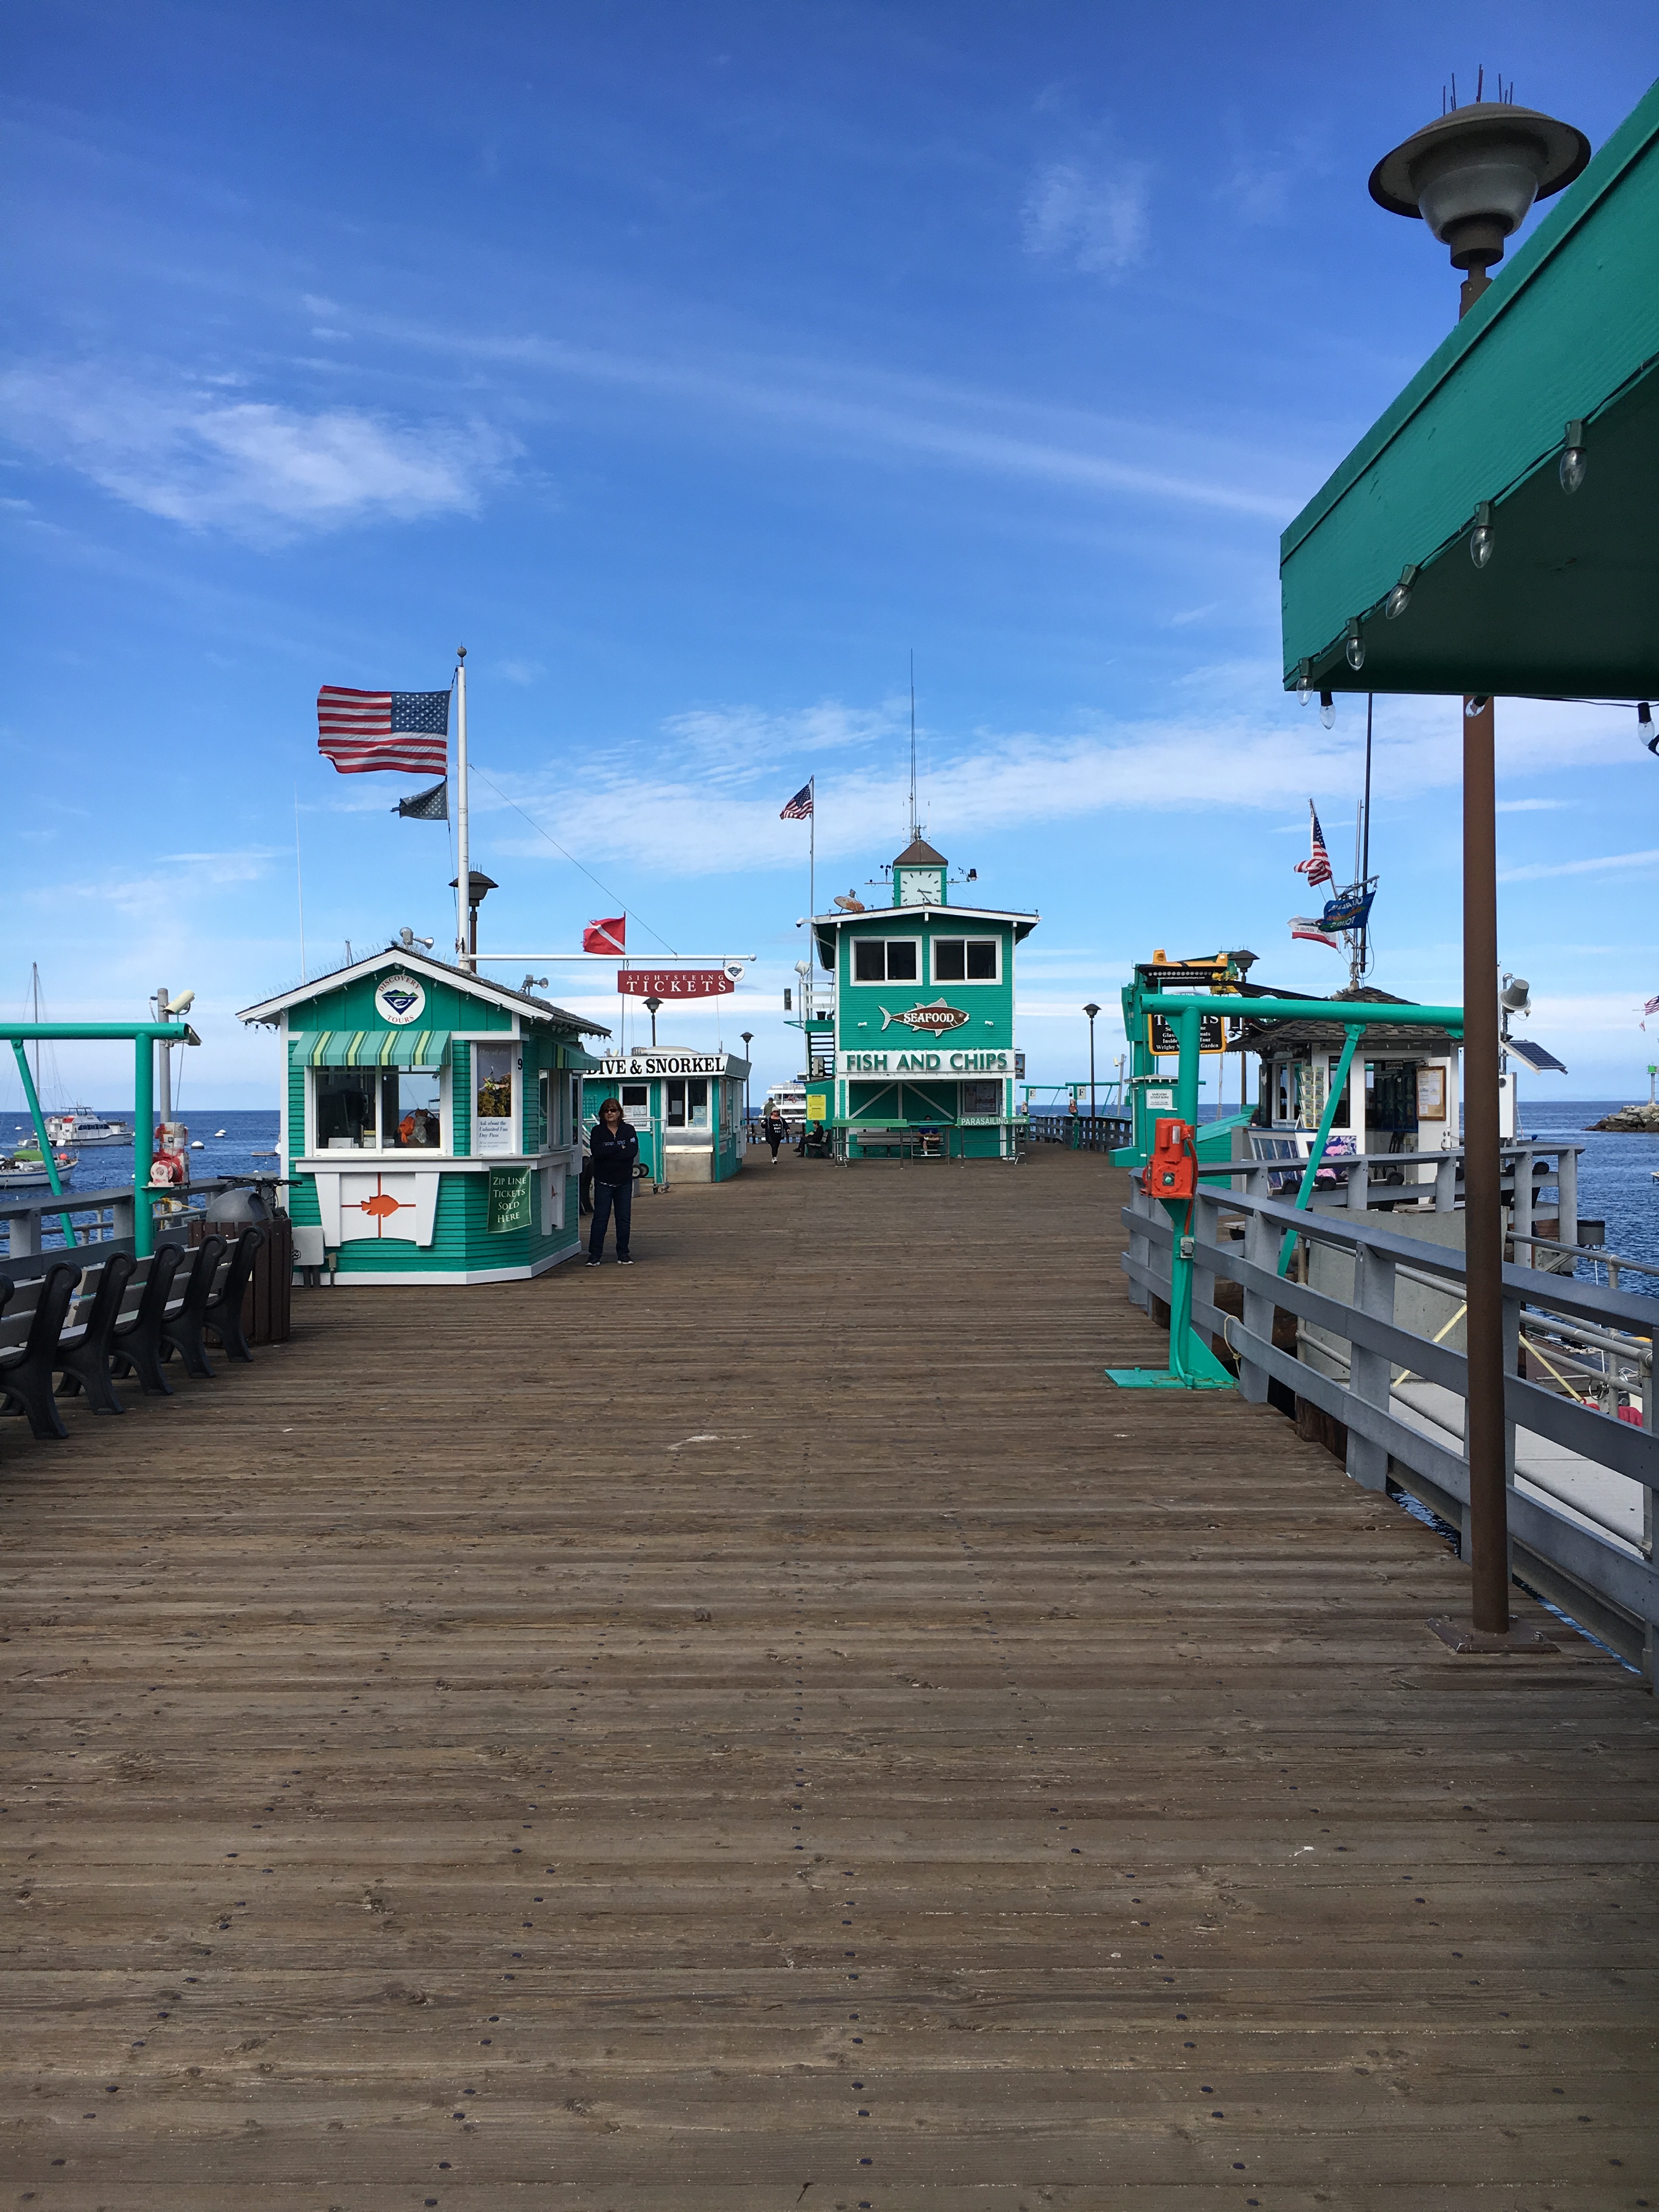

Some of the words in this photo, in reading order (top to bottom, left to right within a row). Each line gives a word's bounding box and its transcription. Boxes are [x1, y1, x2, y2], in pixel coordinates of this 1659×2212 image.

[378, 975, 421, 992] DISCOVERY
[627, 980, 726, 992] TICKETS
[387, 1014, 414, 1023] TOURS
[904, 1013, 954, 1023] SEAFOOD
[517, 1058, 522, 1070] 9
[630, 1059, 642, 1075] &
[646, 1057, 725, 1074] SNORKEL
[847, 1054, 888, 1070] FISH
[896, 1053, 941, 1070] AND
[950, 1053, 1007, 1070] CHIPS
[493, 1177, 505, 1185] ZIP
[508, 1177, 527, 1185] LINE
[493, 1189, 526, 1198] TICKETS
[498, 1201, 520, 1210] SOLD
[498, 1212, 520, 1223] HERE
